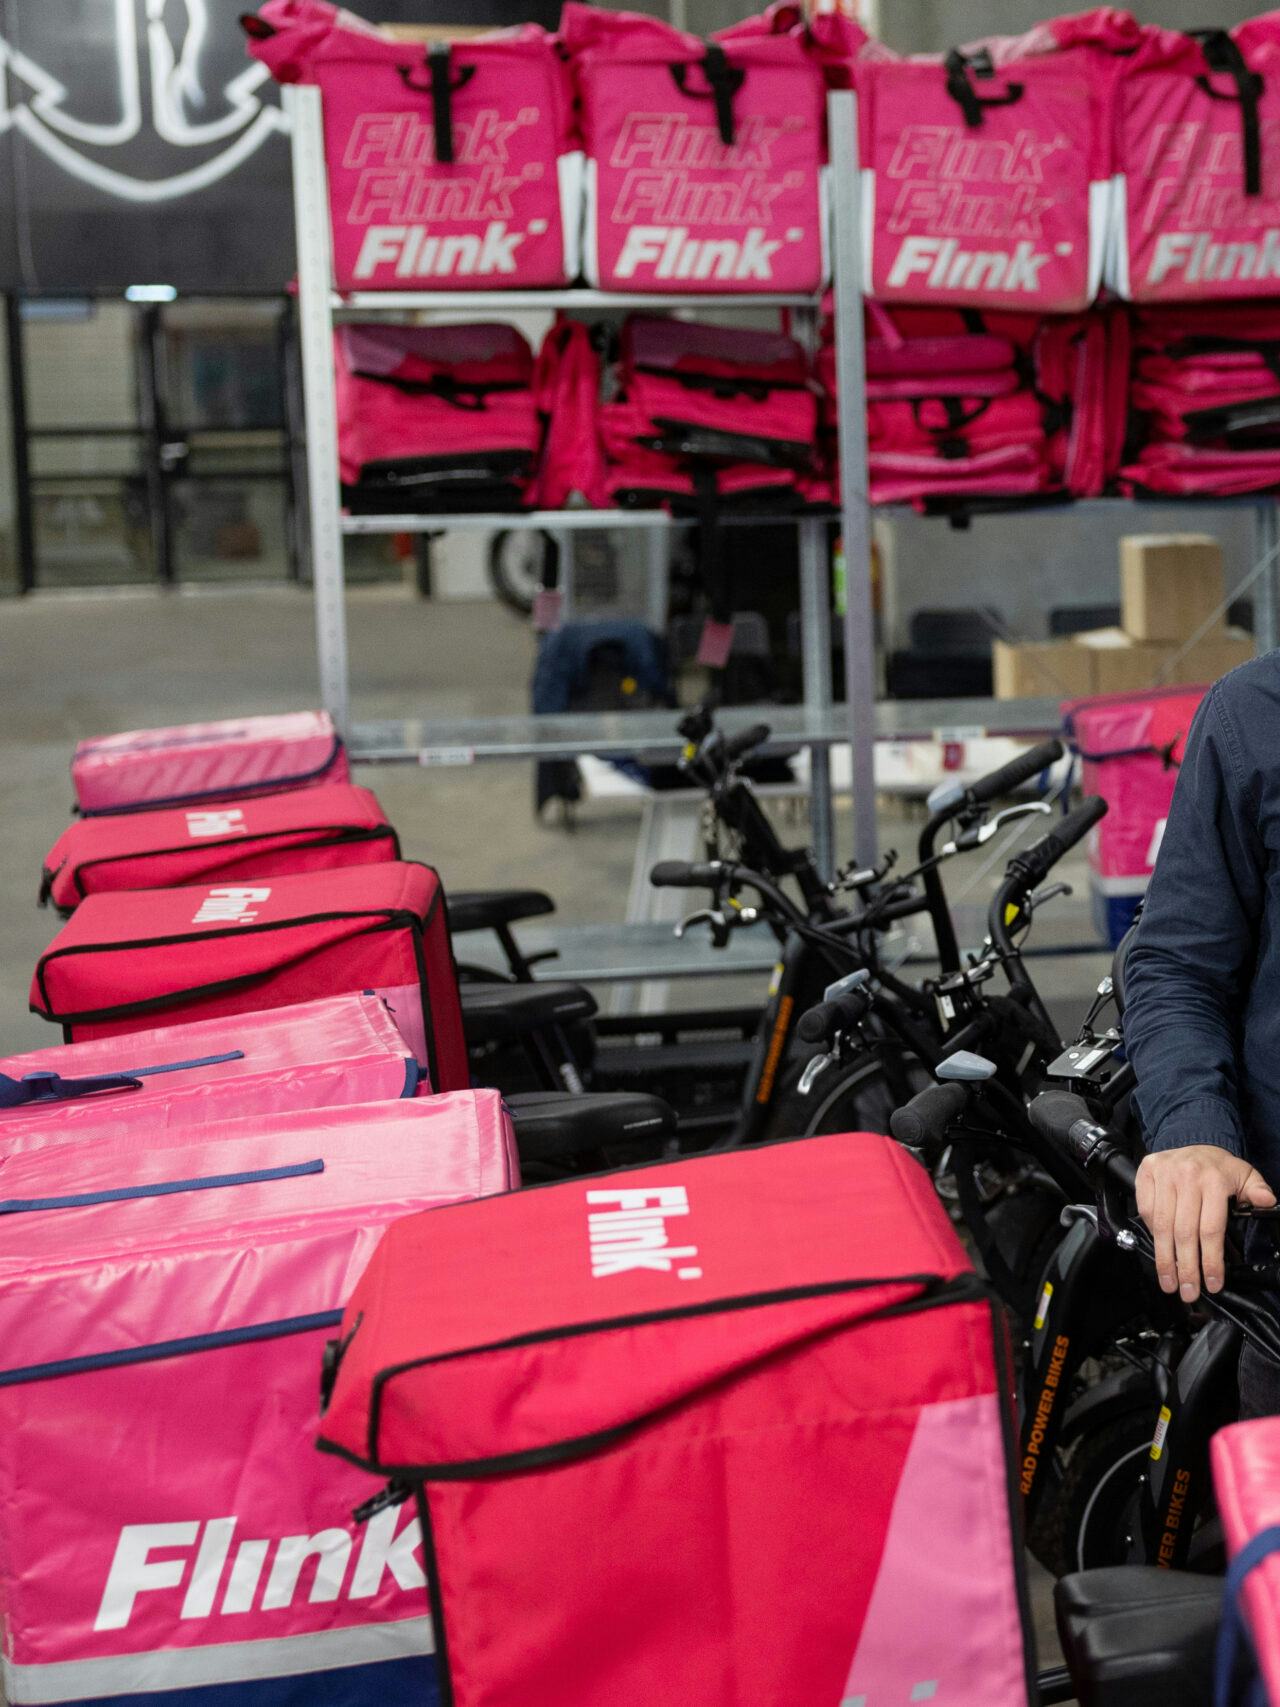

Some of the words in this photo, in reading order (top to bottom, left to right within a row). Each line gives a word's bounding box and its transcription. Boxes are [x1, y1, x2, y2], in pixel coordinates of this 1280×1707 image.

[346, 163, 545, 224] Flink
[611, 168, 806, 225] Flink
[353, 219, 548, 280] Flink
[612, 226, 804, 280] Flink
[886, 235, 1073, 292] Flink
[586, 1186, 703, 1280] Flink
[1044, 1334, 1071, 1388] BIKES
[1027, 1388, 1055, 1456] POWER
[1019, 1455, 1038, 1495] RAD
[1165, 1468, 1191, 1529] BIKES
[92, 1505, 428, 1632] Flink
